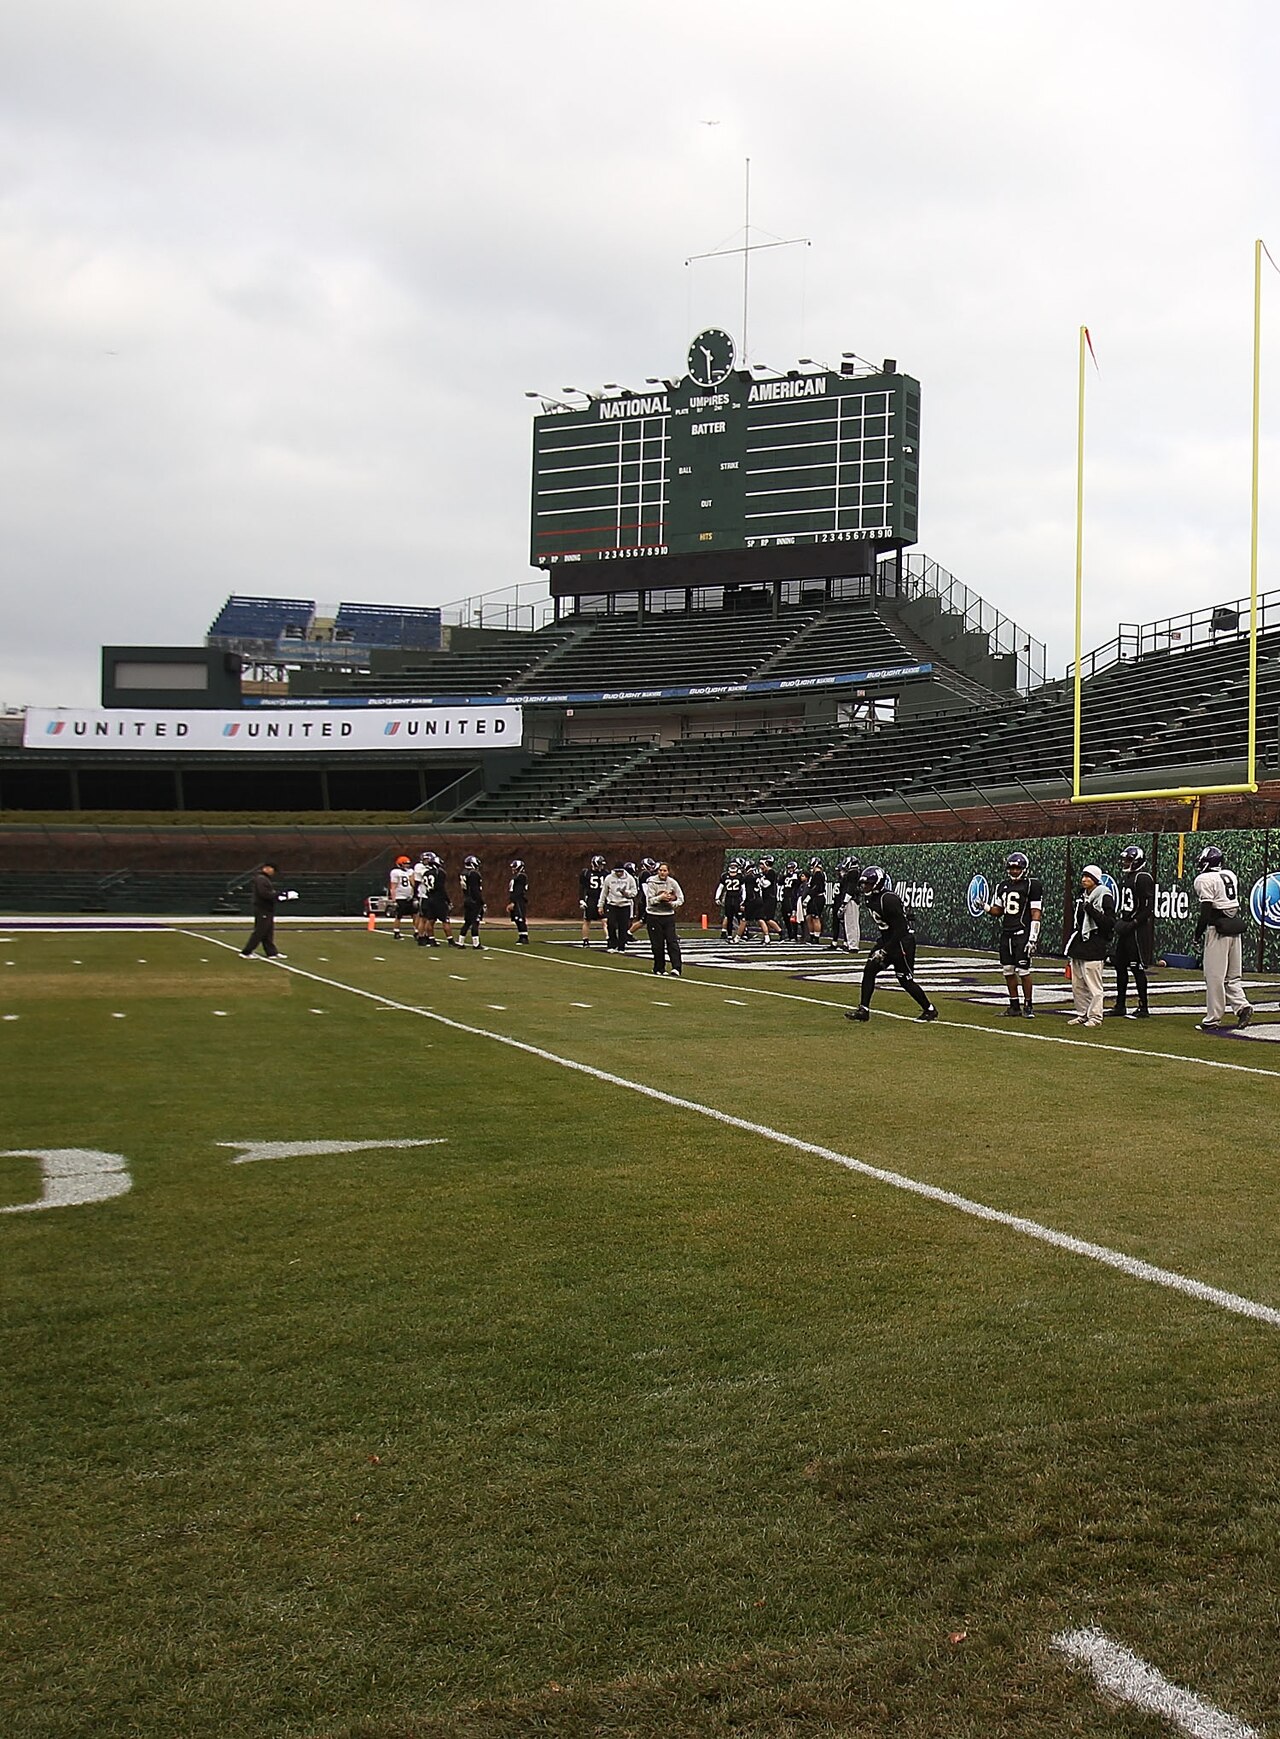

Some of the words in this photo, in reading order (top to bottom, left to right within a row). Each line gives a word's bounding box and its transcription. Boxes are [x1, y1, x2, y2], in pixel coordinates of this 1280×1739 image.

[748, 377, 826, 403] AMERICAN
[600, 396, 672, 420] NATIONAL
[689, 394, 730, 408] UMPIRES
[691, 422, 726, 436] BATTER
[678, 466, 692, 474] BALL
[720, 462, 740, 470] STRIKE
[701, 500, 713, 508] OUT
[699, 532, 713, 541] HITS
[815, 534, 819, 544] 1
[821, 534, 828, 543] 2
[830, 533, 836, 542] 3
[838, 532, 844, 541] 4
[846, 532, 851, 540] 5
[853, 531, 860, 540] 6
[862, 530, 867, 540] 7
[869, 530, 876, 539] 8
[878, 529, 884, 538] 9
[884, 528, 893, 538] 10
[598, 552, 602, 560] 1
[604, 551, 610, 560] 2
[612, 550, 618, 560] 3
[619, 550, 624, 558] 4
[626, 549, 632, 558] 5
[632, 548, 638, 558] 6
[640, 548, 646, 557] 7
[647, 548, 653, 556] 8
[654, 546, 660, 556] 9
[660, 546, 668, 556] 10
[880, 670, 902, 678] LIGHT
[74, 722, 190, 737] UNITED
[248, 722, 352, 737] UNITED
[408, 720, 506, 736] UNITED
[402, 876, 408, 888] 8
[725, 879, 740, 891] 22
[1220, 874, 1236, 900] 8
[894, 881, 934, 909] Allstate
[1121, 886, 1134, 912] 13
[1154, 884, 1189, 919] tate
[1002, 892, 1020, 915] 16
